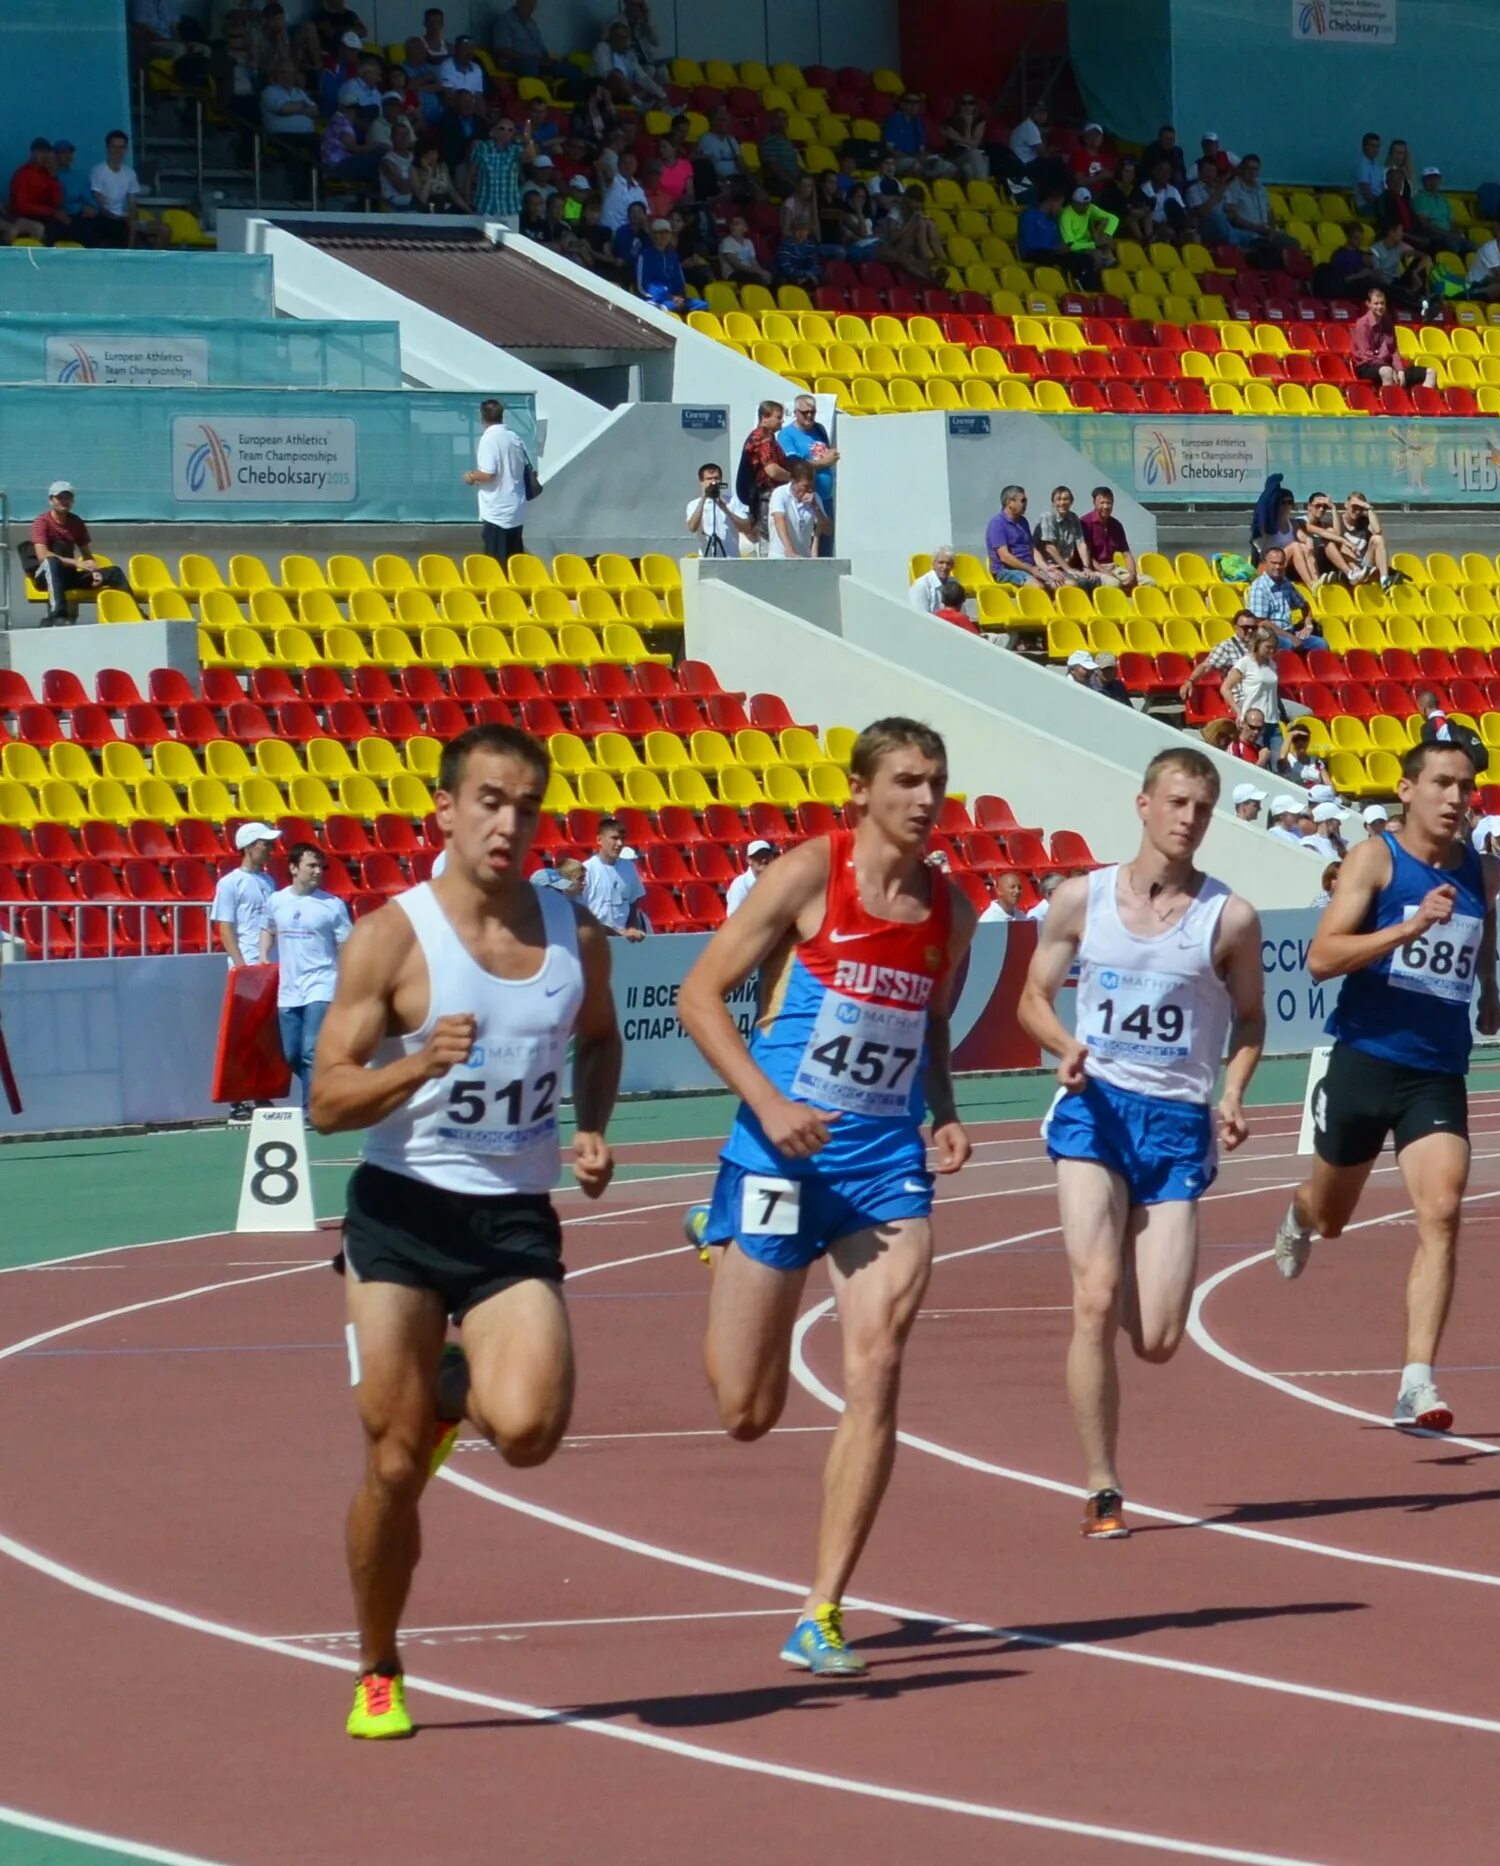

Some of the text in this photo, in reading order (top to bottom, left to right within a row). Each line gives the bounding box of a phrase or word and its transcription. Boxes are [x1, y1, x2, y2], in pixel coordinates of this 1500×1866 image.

[104, 351, 183, 363] European Athletics
[104, 365, 192, 378] Team Championships
[239, 433, 328, 447] European Athletics
[239, 450, 337, 465] Team Championships
[1402, 936, 1475, 980] 685
[833, 959, 935, 1004] RUSSIA
[1097, 998, 1184, 1043] 149
[811, 1034, 917, 1089] 457
[447, 1070, 557, 1126] 512
[250, 1141, 299, 1206] 8
[759, 1188, 784, 1226] 7
